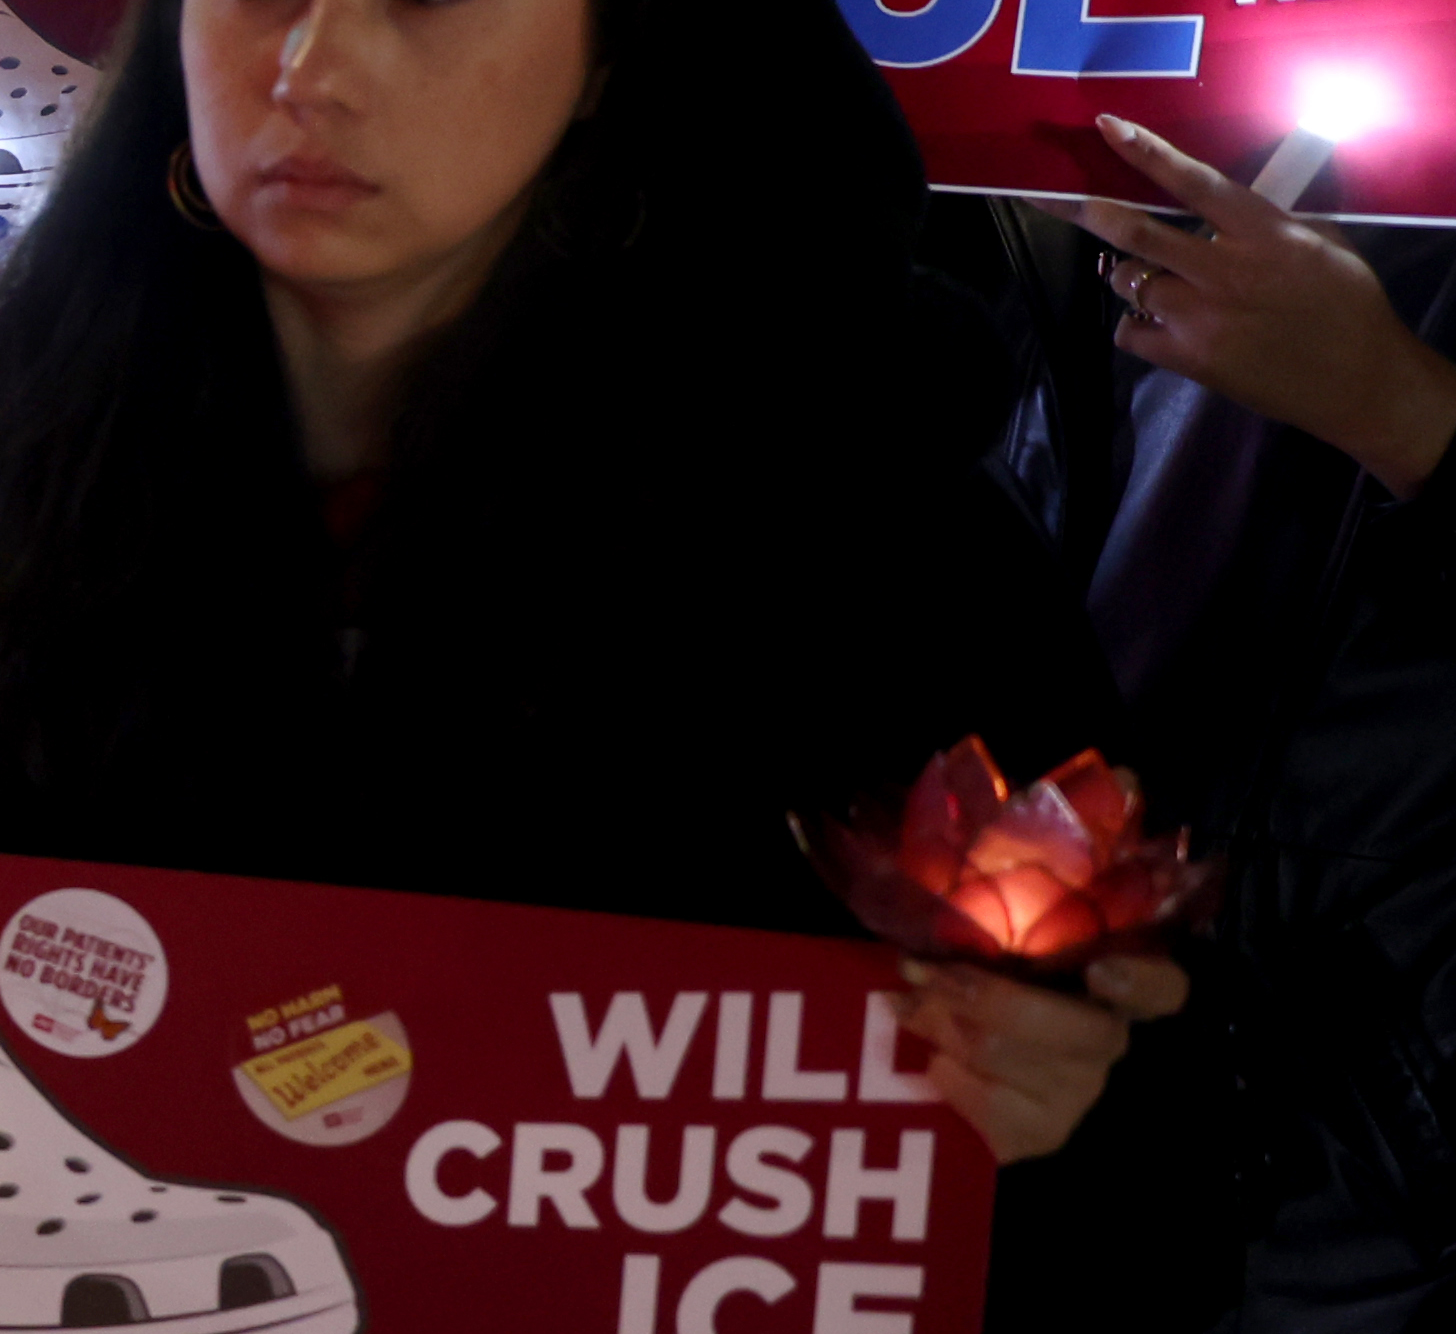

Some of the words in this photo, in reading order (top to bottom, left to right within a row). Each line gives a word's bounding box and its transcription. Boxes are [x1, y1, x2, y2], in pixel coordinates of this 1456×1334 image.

[19, 914, 59, 938] OUR
[5, 953, 36, 978] NO
[39, 964, 135, 1013] BORDERS
[12, 932, 86, 972] RIGHTS
[90, 957, 145, 991] HAVE
[246, 1006, 280, 1032] NO
[251, 1025, 287, 1052] NO
[287, 1003, 346, 1039] FEAR
[548, 989, 943, 1104] WILL
[404, 1119, 936, 1243] CRUSH
